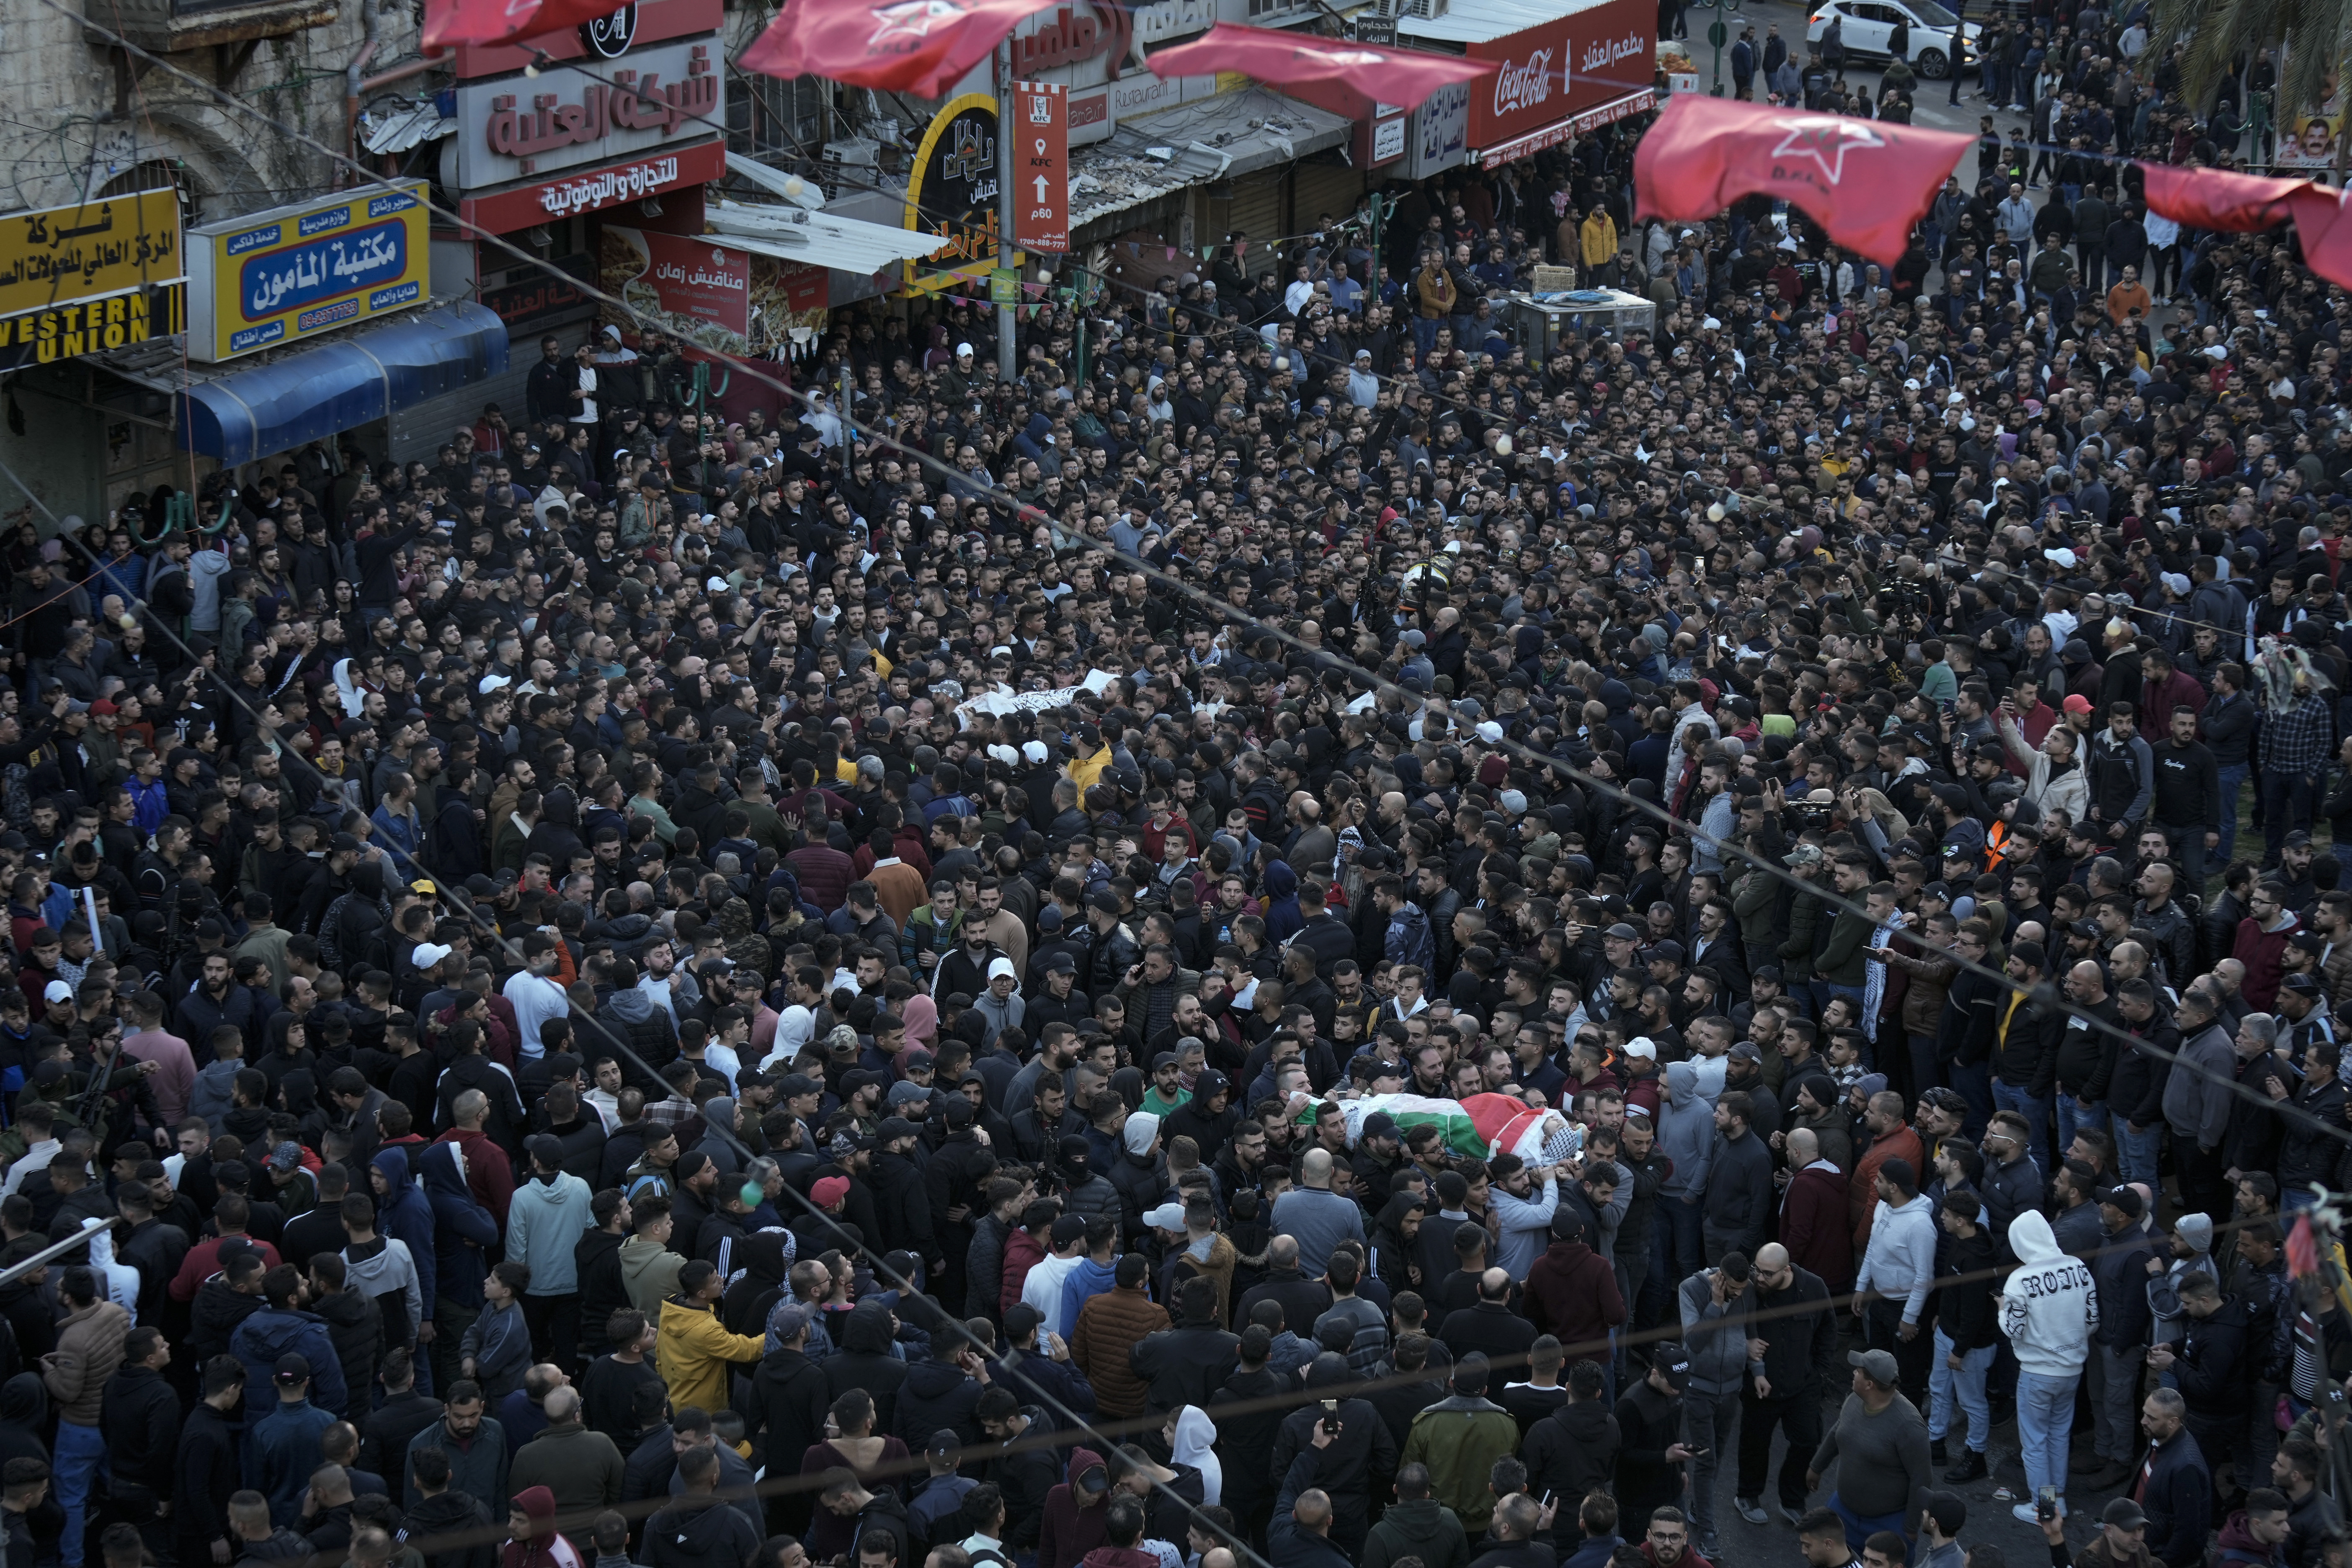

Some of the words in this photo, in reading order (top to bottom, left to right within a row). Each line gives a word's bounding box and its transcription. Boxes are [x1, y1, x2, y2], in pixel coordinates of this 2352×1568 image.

[1359, 21, 1394, 31] الحجاوي
[1582, 39, 1611, 72] العقاد
[1612, 31, 1643, 67] مطعم
[610, 45, 717, 135] شركة
[1494, 46, 1554, 117] Coca-Cola
[487, 84, 610, 175] العتبة
[1425, 122, 1464, 162] للصرافة
[1030, 157, 1052, 167] KFC
[627, 157, 677, 196] للتجارة
[971, 178, 998, 204] اقيش
[392, 198, 415, 210] صوير
[24, 202, 111, 248] شركة
[302, 216, 330, 233] مدرسية
[330, 210, 348, 228] لوازم
[230, 233, 254, 254] فاكس
[255, 228, 278, 244] خدمة
[1020, 238, 1065, 248] 1700-888-777
[1052, 231, 1065, 240] أطلب
[132, 230, 173, 266] المركز
[333, 231, 397, 284] مكتبة
[83, 238, 128, 285] العالمي
[253, 250, 327, 310] المأمون
[657, 262, 686, 284] زمان
[689, 266, 743, 290] مناقيش
[371, 291, 396, 308] وألعاب
[397, 285, 418, 302] هدايا
[548, 281, 587, 304] ركة
[299, 300, 358, 329] 09-2377723
[492, 288, 545, 322] العتبة
[37, 317, 150, 364] UNION
[233, 328, 258, 350] أطفال
[259, 322, 282, 343] قصص
[2164, 758, 2186, 771] Replay
[1902, 847, 1922, 861] NIKE
[1937, 891, 1951, 905] NIK
[1672, 1361, 1689, 1372] BOSS
